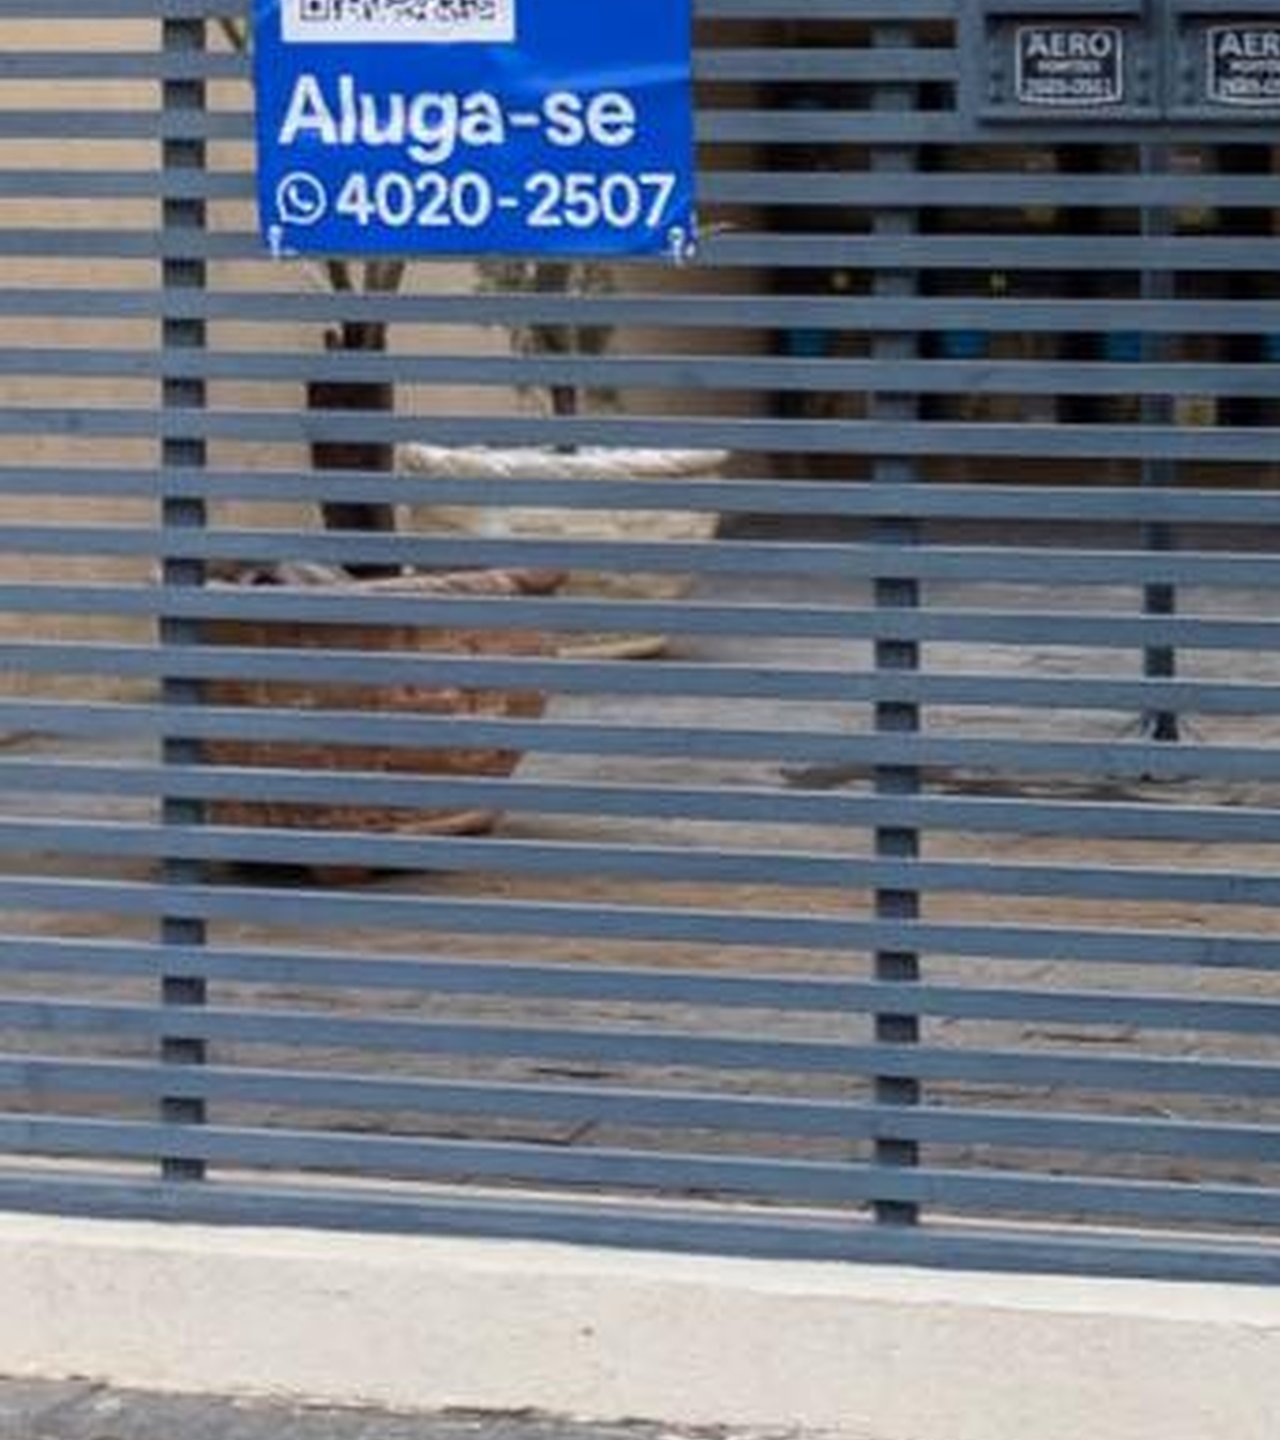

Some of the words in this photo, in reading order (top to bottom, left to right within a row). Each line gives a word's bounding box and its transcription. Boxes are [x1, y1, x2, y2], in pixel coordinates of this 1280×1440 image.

[1026, 32, 1112, 59] AERO
[278, 74, 636, 163] Aluga-se
[337, 172, 677, 226] 4020-2507
